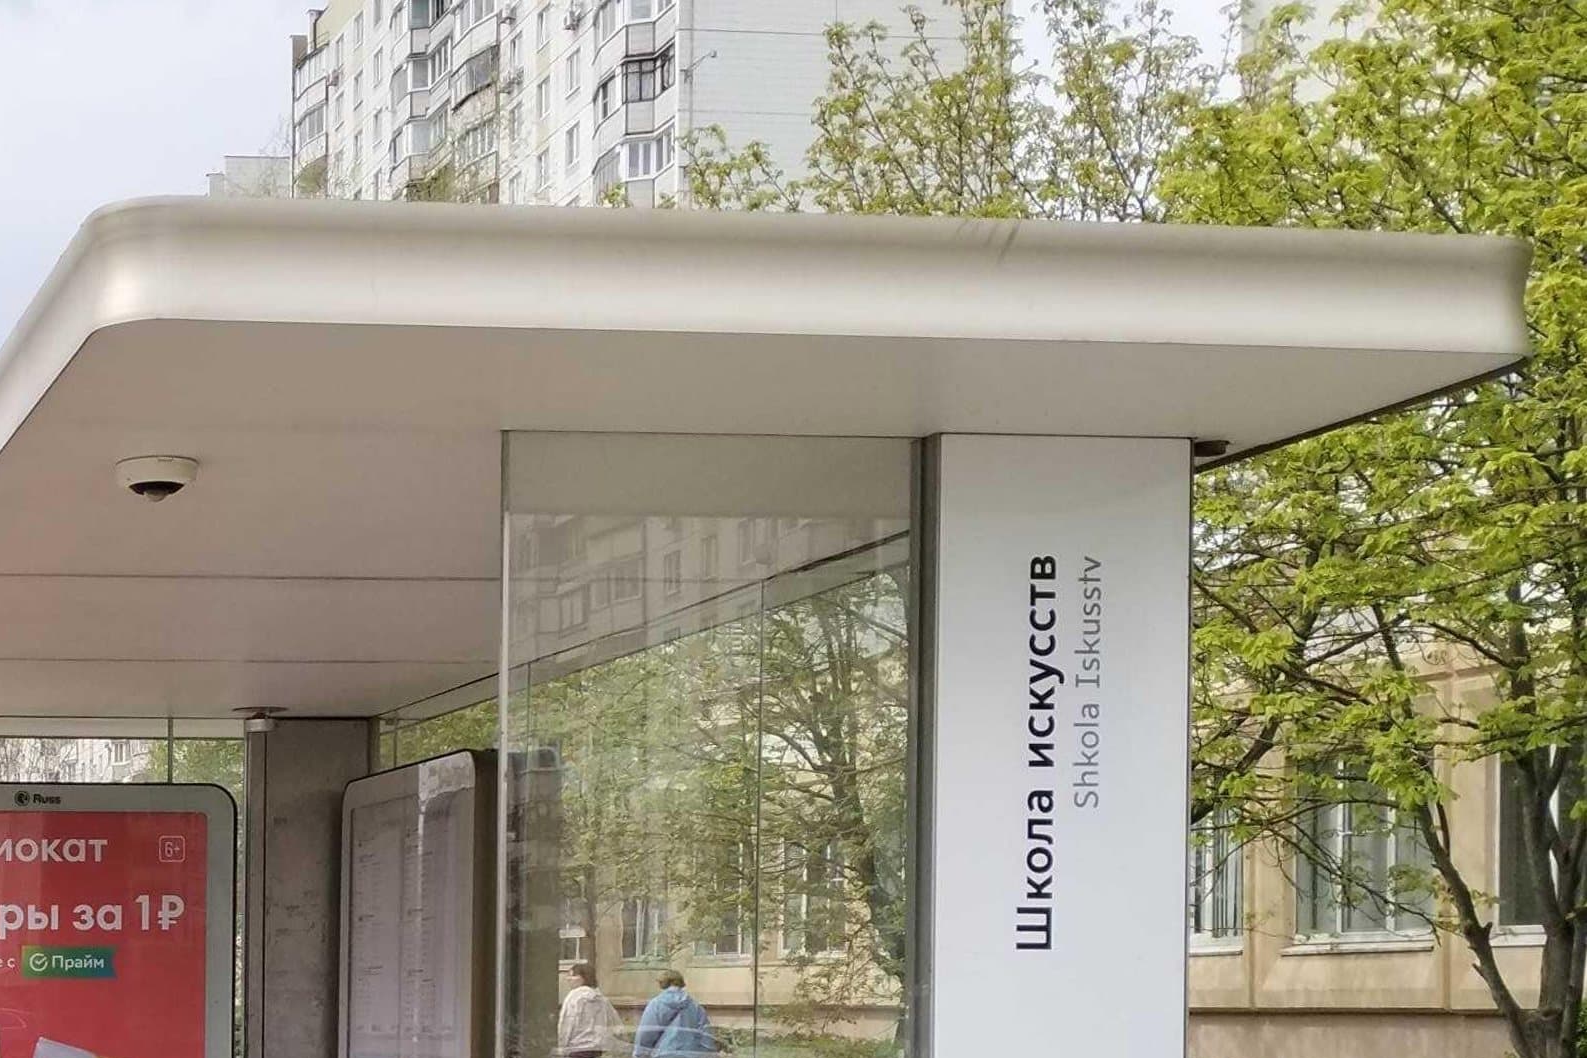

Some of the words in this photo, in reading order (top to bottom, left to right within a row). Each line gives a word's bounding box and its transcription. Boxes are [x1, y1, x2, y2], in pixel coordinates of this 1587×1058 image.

[1073, 555, 1102, 690] Iskusstv
[1027, 554, 1065, 769] искусств
[1073, 702, 1101, 809] Shkola
[32, 793, 61, 805] Russ
[1015, 788, 1054, 950] Школа
[72, 903, 123, 931] за
[6, 957, 16, 968] с
[51, 954, 105, 970] Прайм
